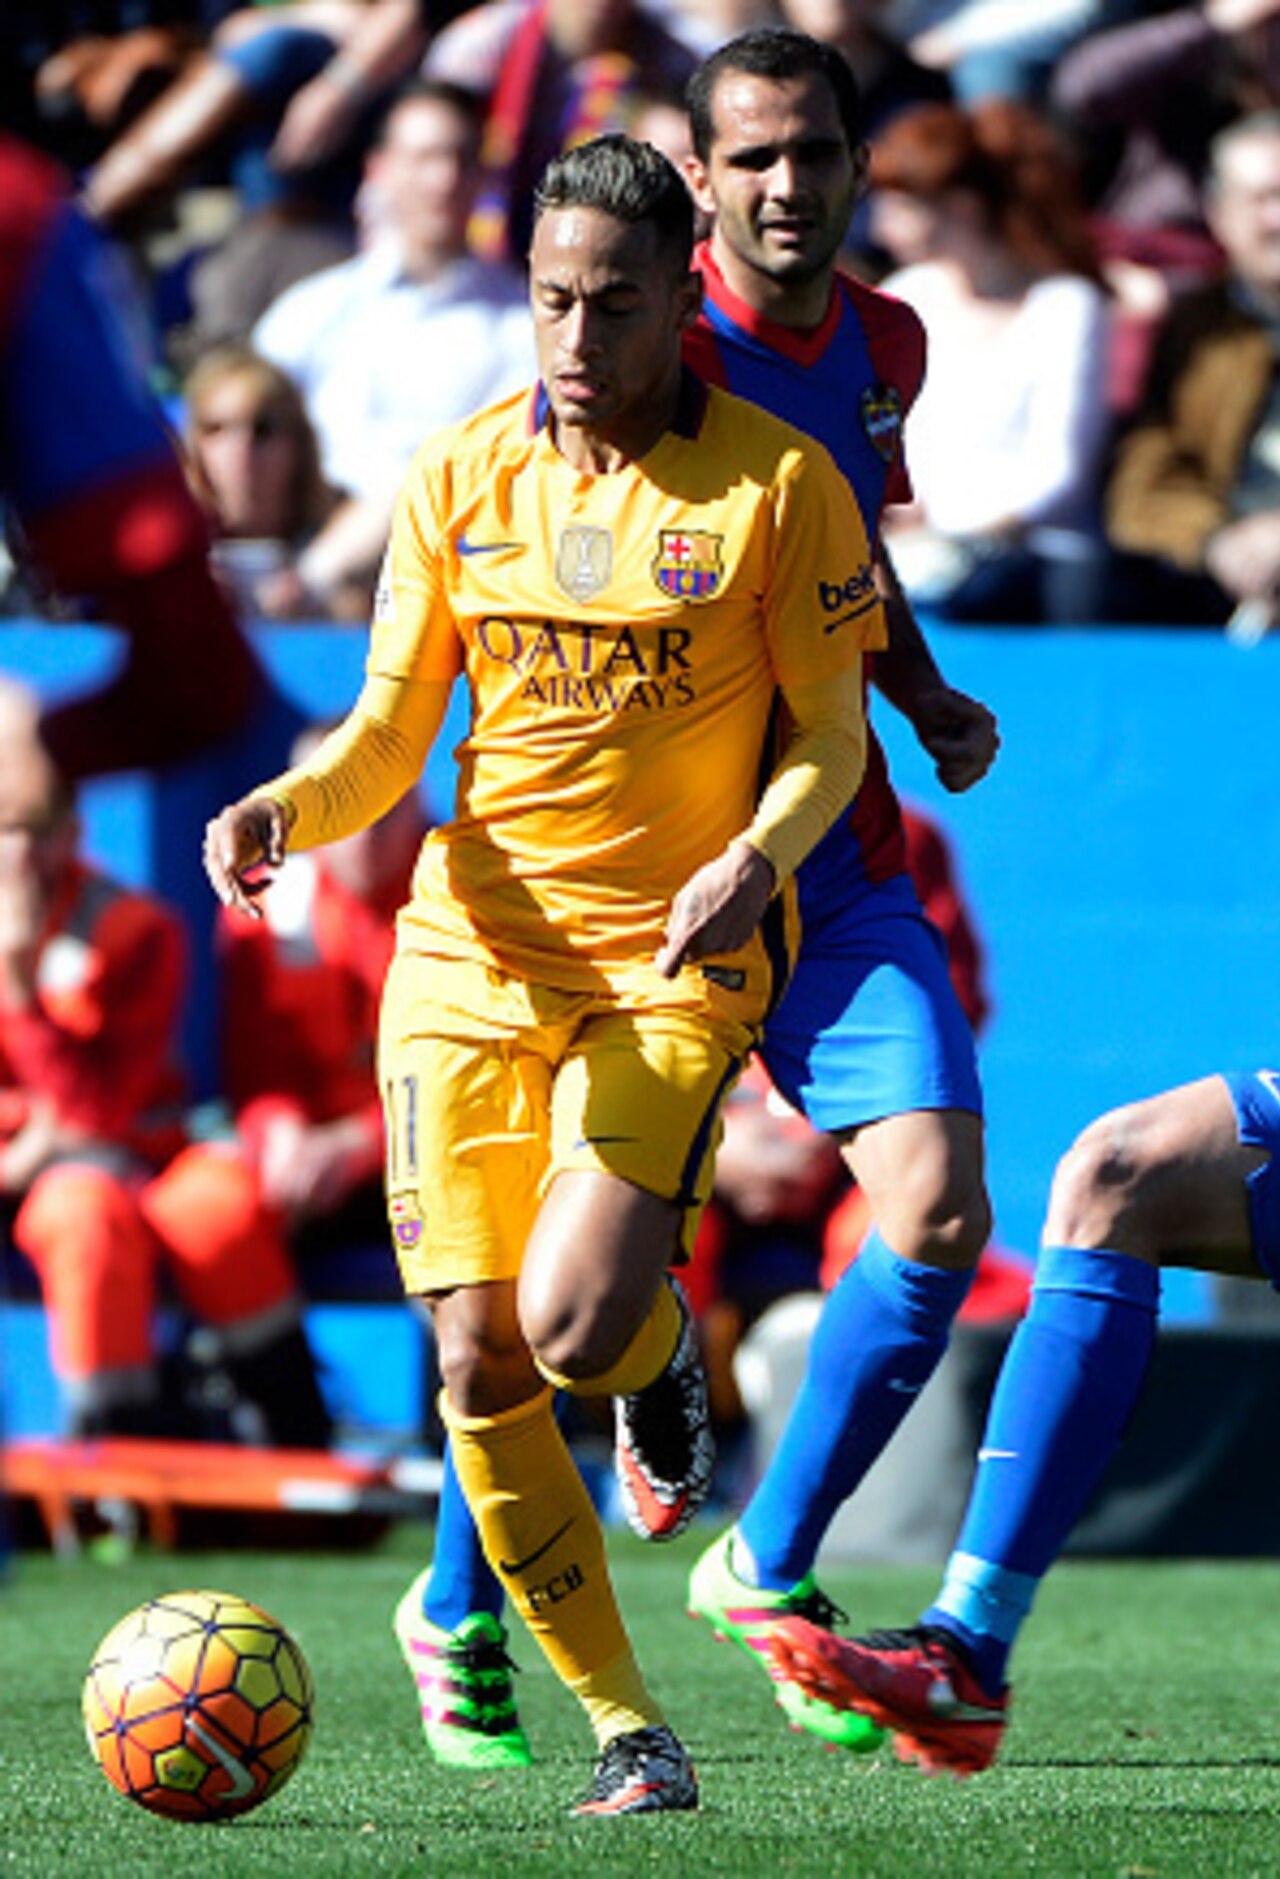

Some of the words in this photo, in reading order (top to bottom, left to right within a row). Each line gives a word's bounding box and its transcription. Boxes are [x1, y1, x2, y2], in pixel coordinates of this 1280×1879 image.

[478, 615, 692, 676] QATAR
[520, 672, 695, 712] AIRWAYS
[526, 1563, 584, 1612] FCB
